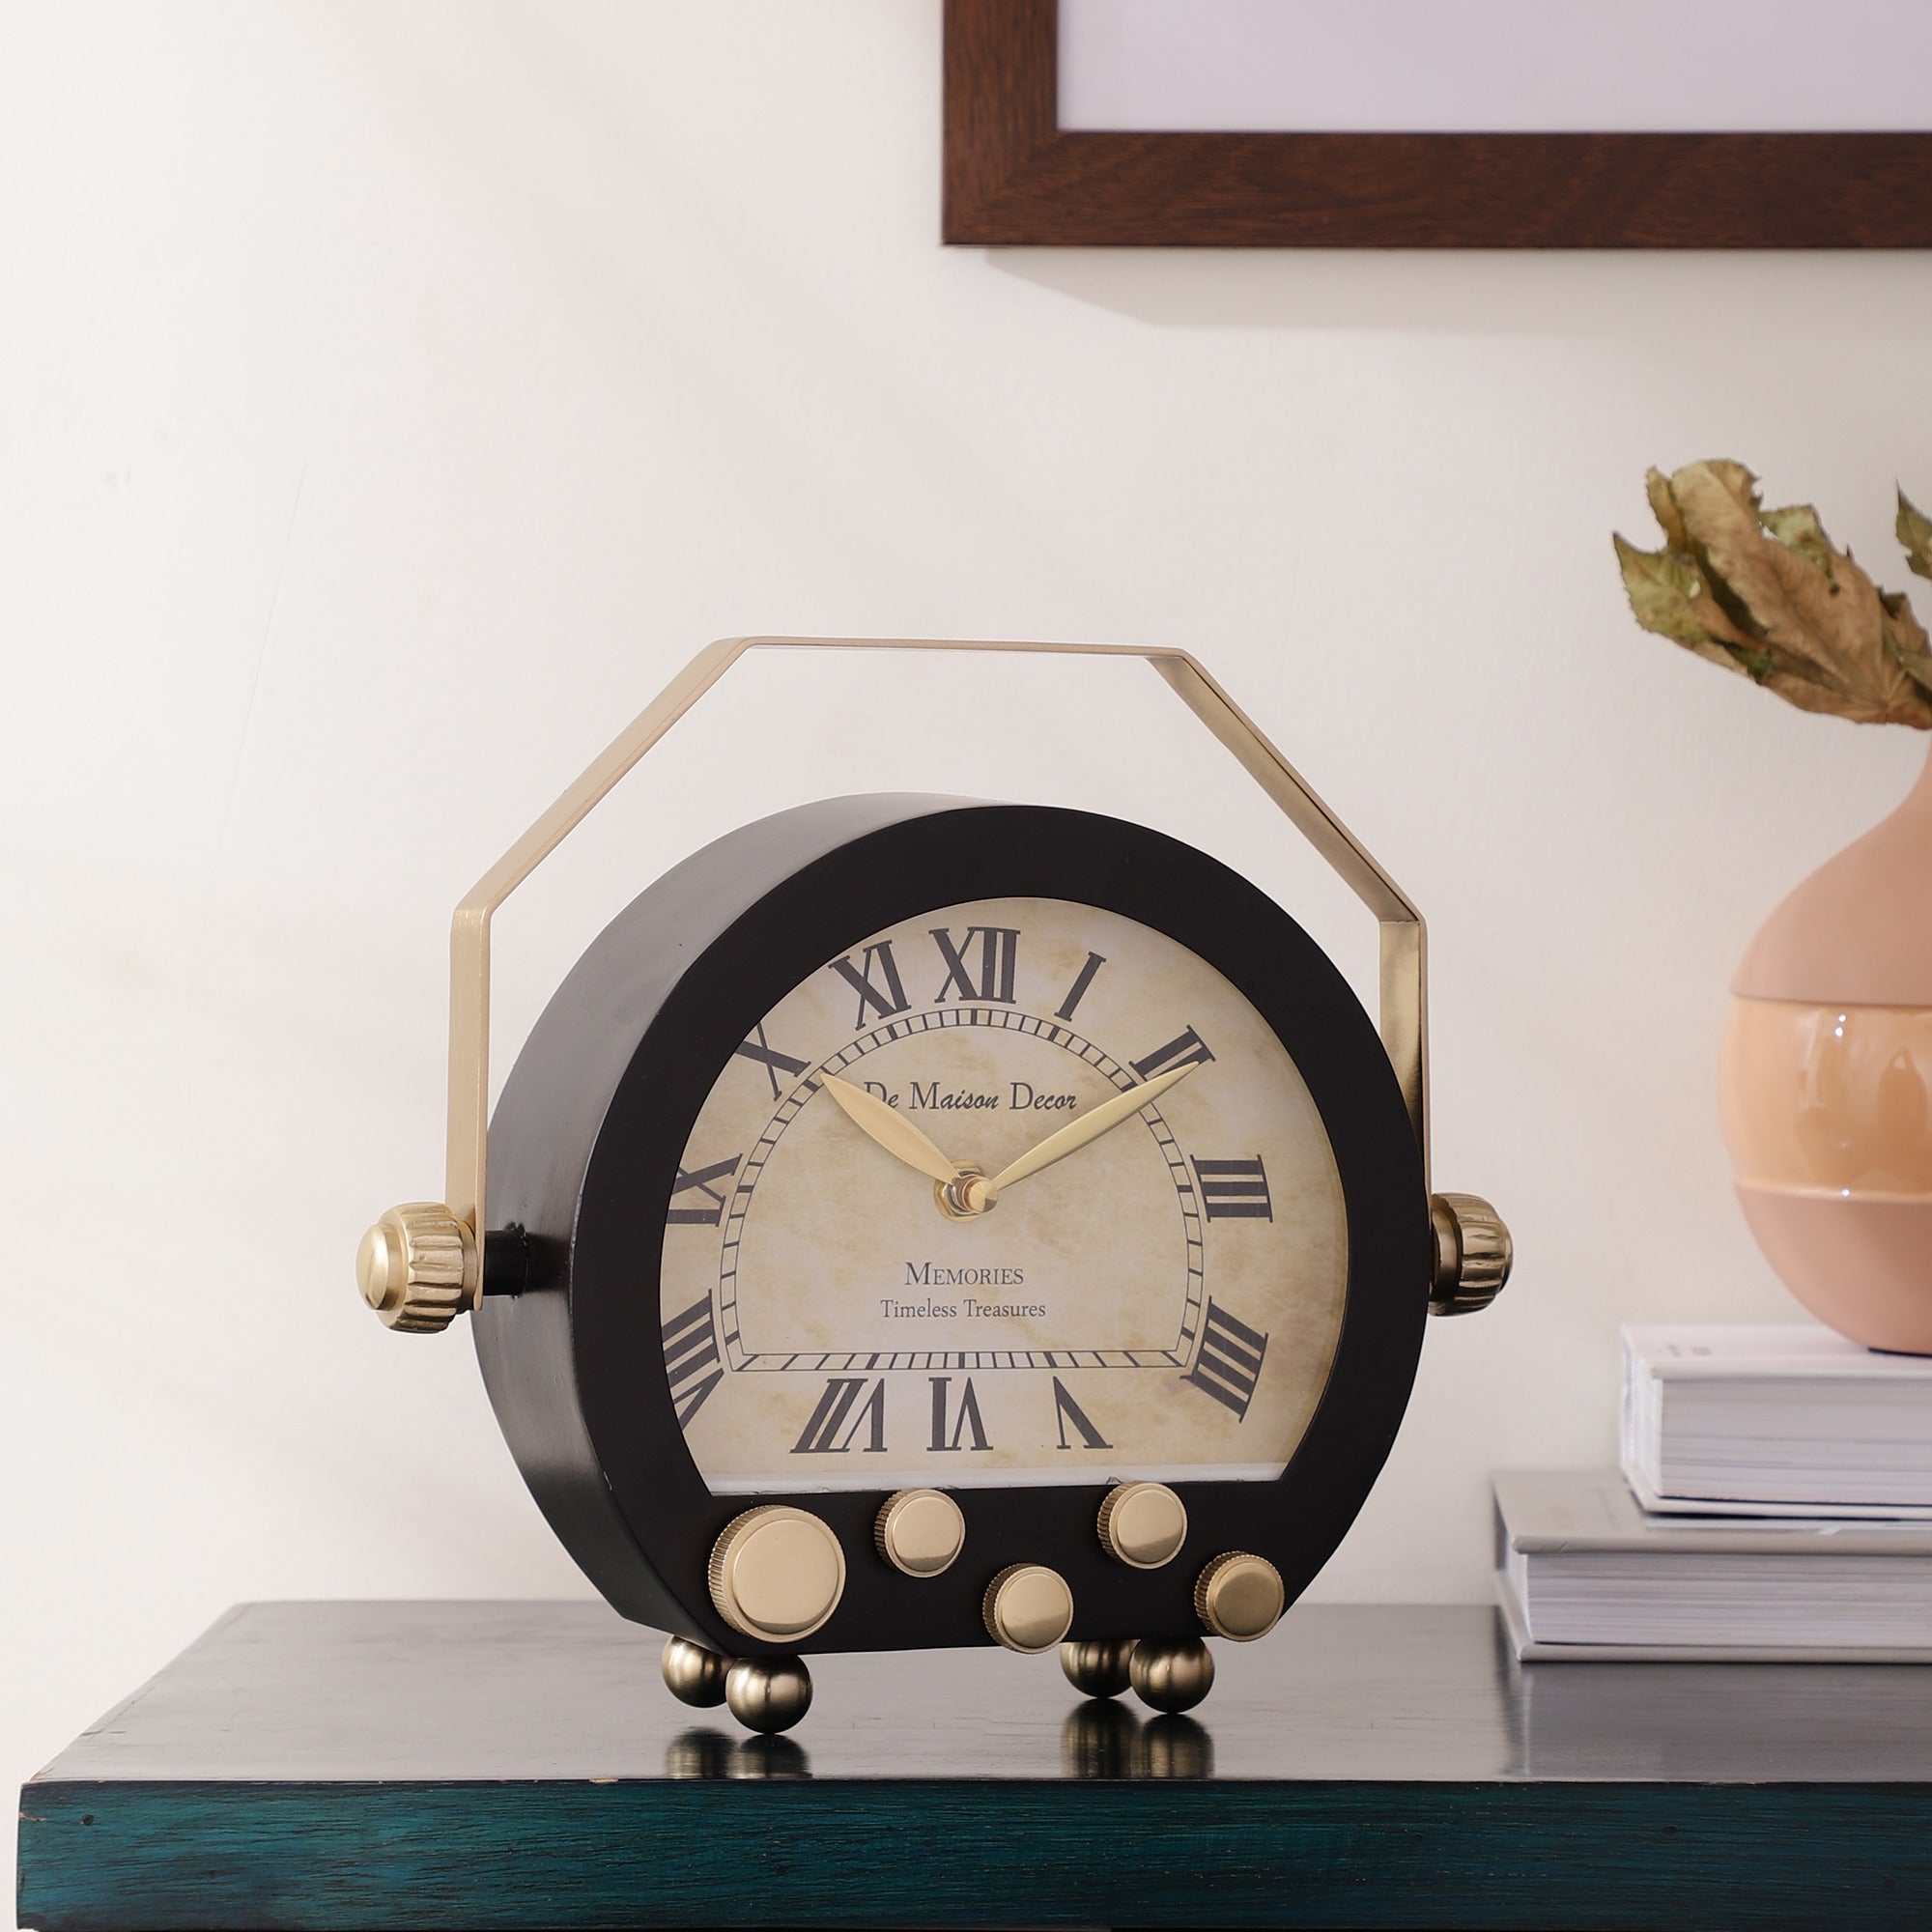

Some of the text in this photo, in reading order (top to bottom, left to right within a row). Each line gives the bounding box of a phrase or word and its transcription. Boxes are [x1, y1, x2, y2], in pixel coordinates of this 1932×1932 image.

[828, 940, 912, 1031] XI
[928, 926, 1021, 1004] XII
[1054, 951, 1106, 1022] I
[864, 1081, 1077, 1110] De Maison Decor
[1189, 1154, 1273, 1223] III
[880, 1298, 1046, 1319] Timeless Treasures
